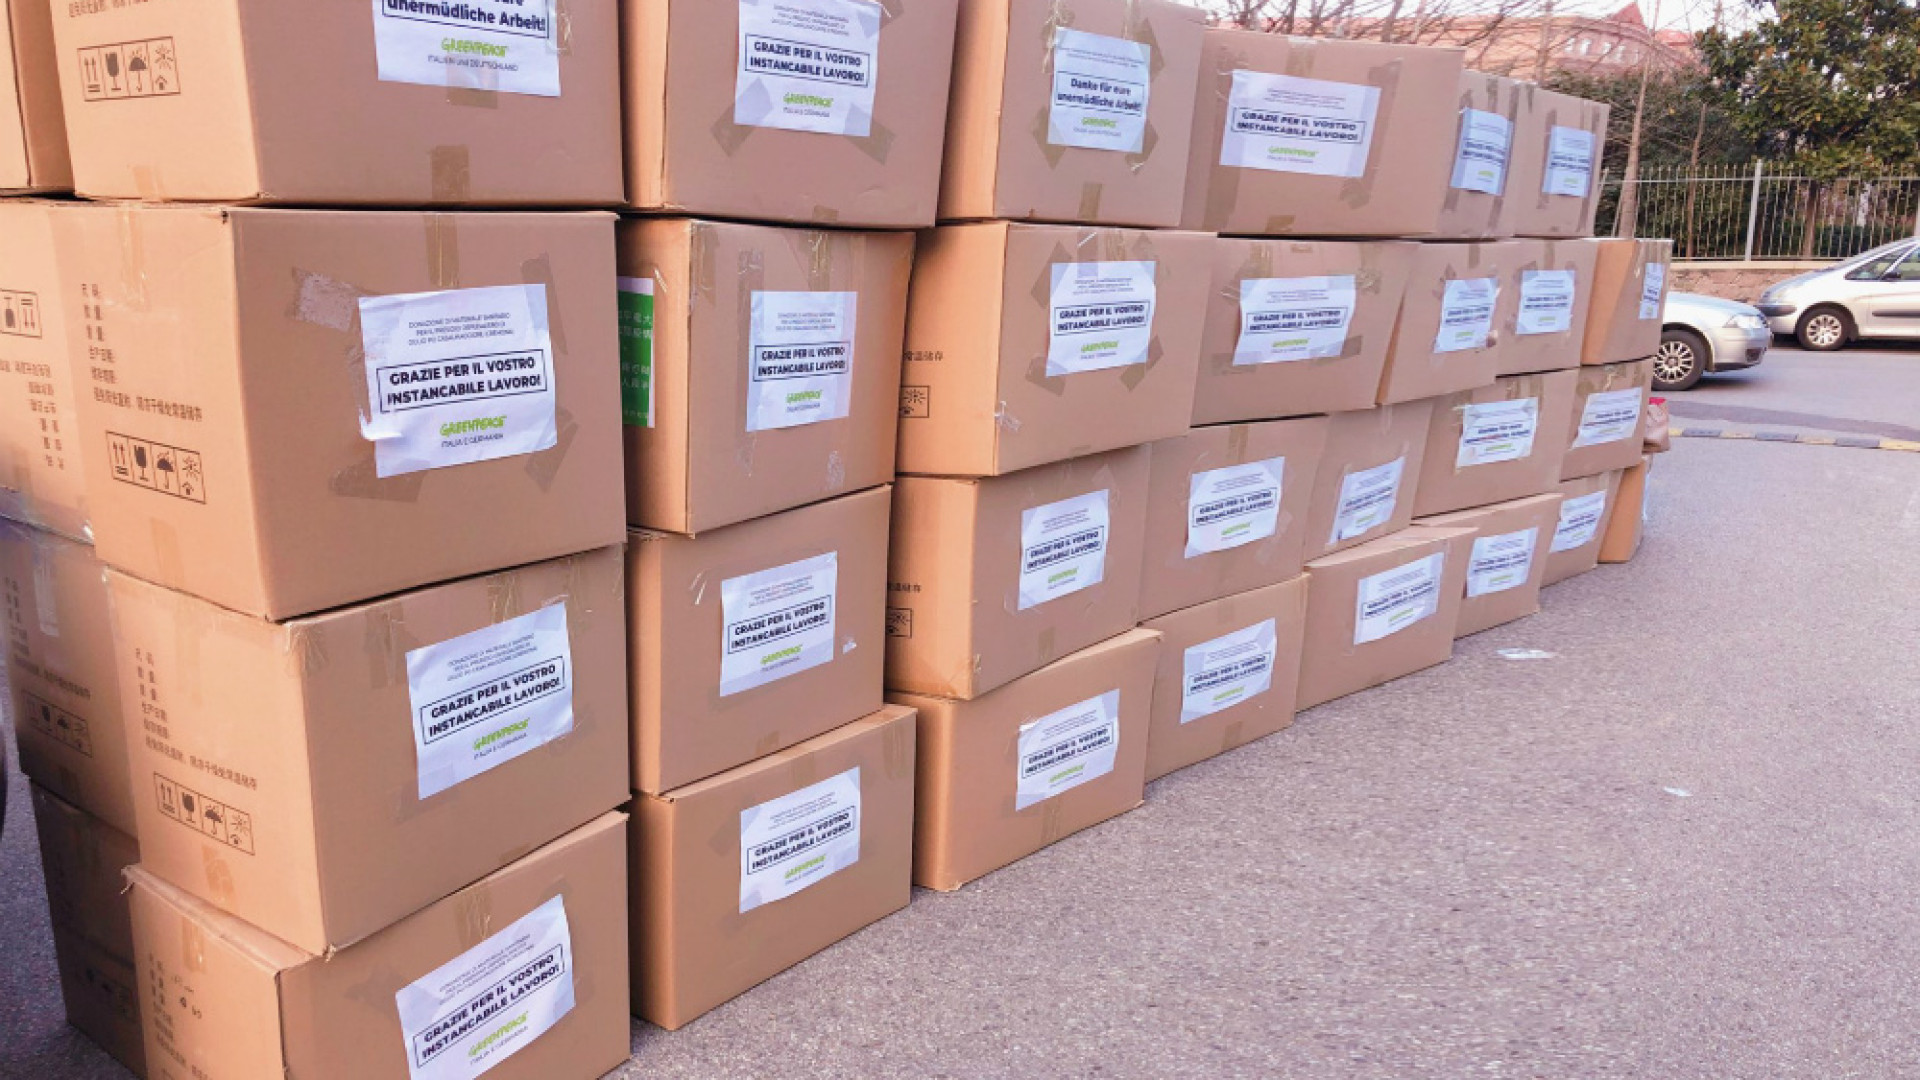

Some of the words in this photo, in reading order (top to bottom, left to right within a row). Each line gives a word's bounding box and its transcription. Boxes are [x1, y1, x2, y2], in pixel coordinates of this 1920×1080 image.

[388, 0, 495, 23] unermüdliche
[499, 12, 545, 31] Arbeit!
[441, 38, 506, 57] GREENPEACE
[754, 42, 791, 56] GRAZIE
[793, 48, 812, 59] PER
[814, 51, 822, 61] IL
[826, 52, 861, 67] VOSTRO
[751, 56, 820, 75] INSTANCABILE
[824, 67, 864, 81] LAVORO!
[1071, 79, 1098, 90] Danke
[1100, 83, 1112, 92] für
[1242, 112, 1278, 123] GRAZIE
[1281, 117, 1300, 125] PER
[1313, 121, 1356, 130] VOSTRO
[1309, 130, 1358, 140] LAVORO!
[762, 350, 791, 361] GRAZIE
[793, 349, 807, 359] PER
[808, 349, 815, 357] IL
[818, 347, 845, 357] VOSTRO
[816, 360, 845, 370] LAVORO!
[390, 369, 441, 385] GRAZIE
[445, 364, 469, 377] PER
[473, 363, 484, 374] IL
[487, 357, 534, 372] VOSTRO
[387, 382, 484, 405] INSTANCABILE
[488, 374, 540, 392] LAVORO!
[440, 416, 507, 436] GREENPEACE
[735, 619, 765, 635] GRAZIE
[768, 615, 783, 626] PER
[795, 602, 824, 616] VOSTRO
[793, 614, 826, 629] LAVORO!
[432, 693, 473, 718] GRAZIE
[478, 684, 498, 700] PER
[501, 681, 510, 691] IL
[514, 664, 555, 686] VOSTRO
[430, 695, 512, 737] INSTANCABILE
[514, 677, 559, 701] LAVORO!
[424, 1009, 468, 1042] GRAZIE
[472, 991, 494, 1013] PER
[497, 986, 507, 996] IL
[509, 955, 553, 986] VOSTRO
[422, 997, 508, 1059] INSTANCABILE
[511, 964, 559, 1000] LAVORO!
